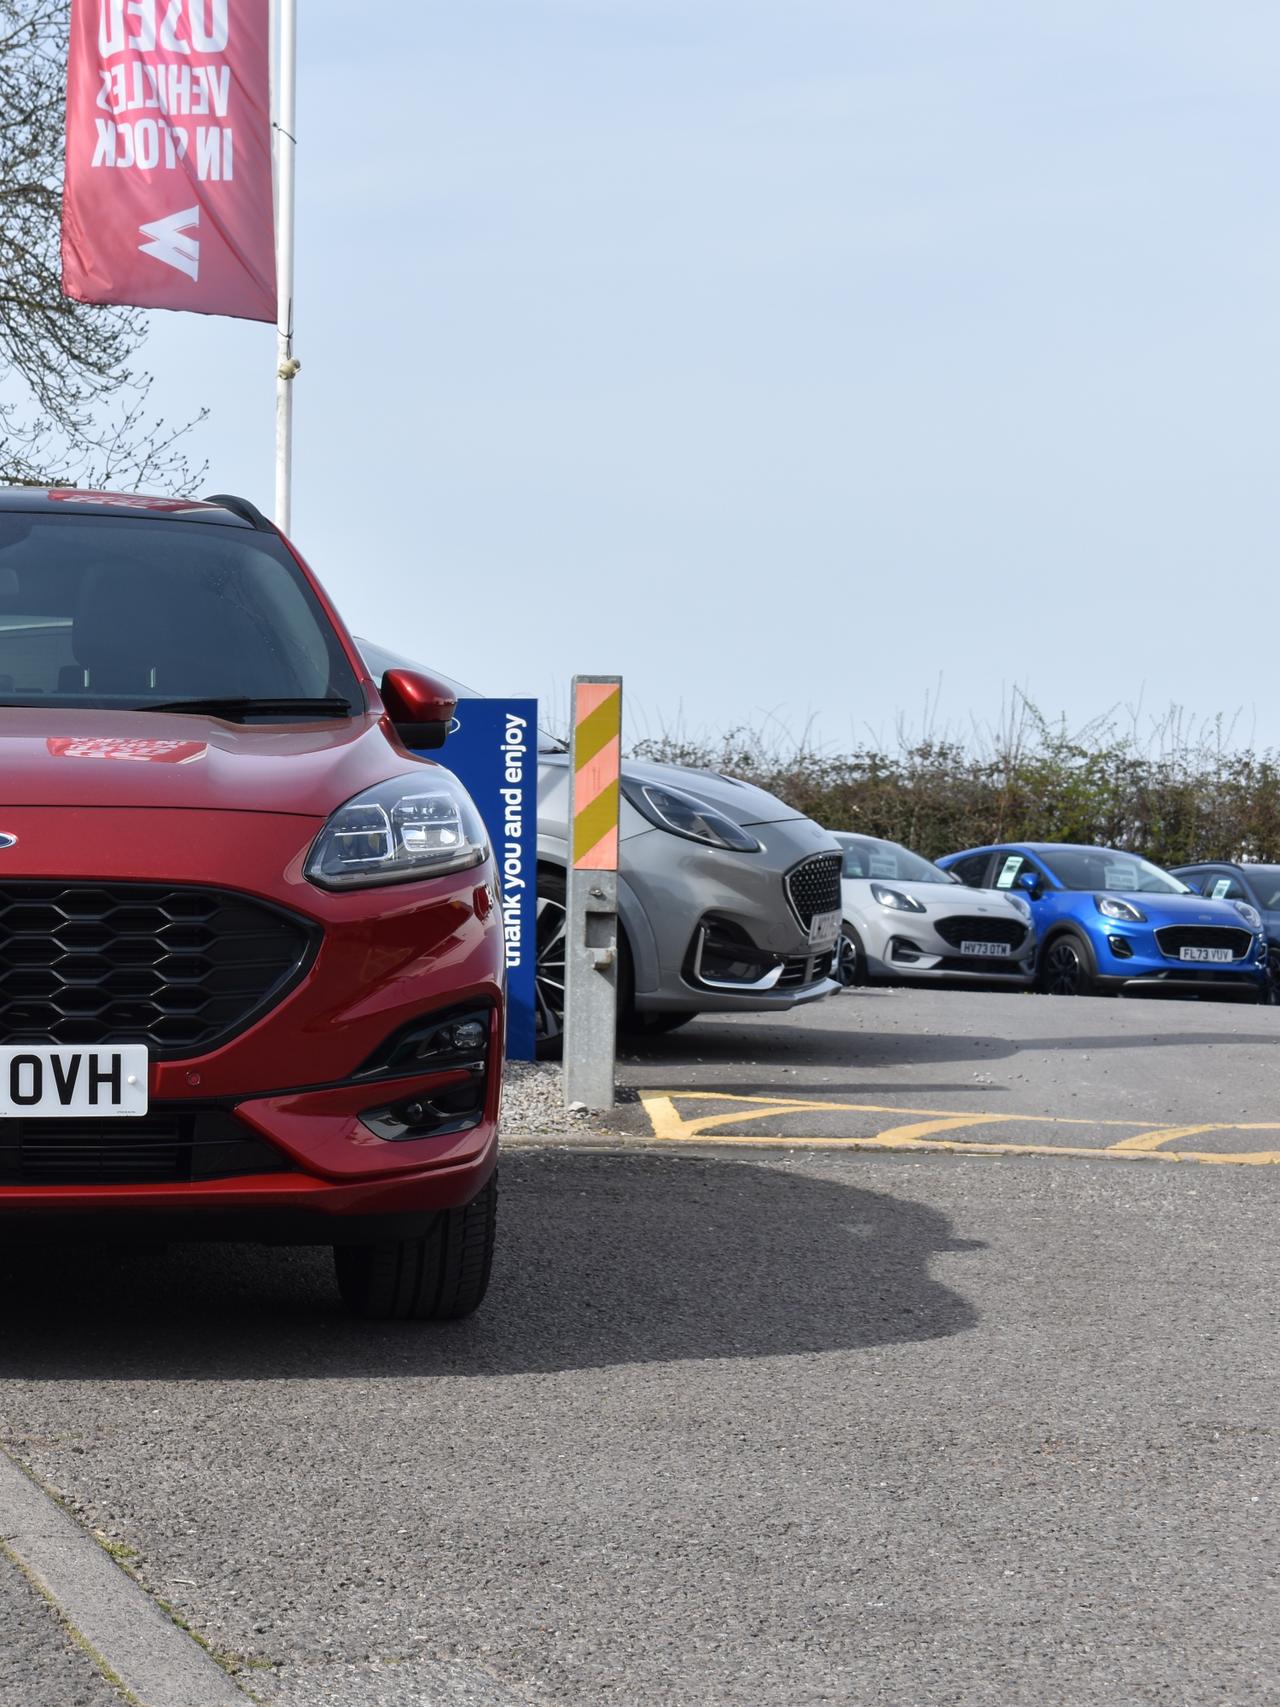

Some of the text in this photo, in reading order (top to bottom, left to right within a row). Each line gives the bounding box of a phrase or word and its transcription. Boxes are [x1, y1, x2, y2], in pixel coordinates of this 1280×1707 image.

[501, 713, 527, 783] enjoy
[500, 788, 523, 838] and
[504, 842, 526, 889] you
[10, 1054, 122, 1105] OVH
